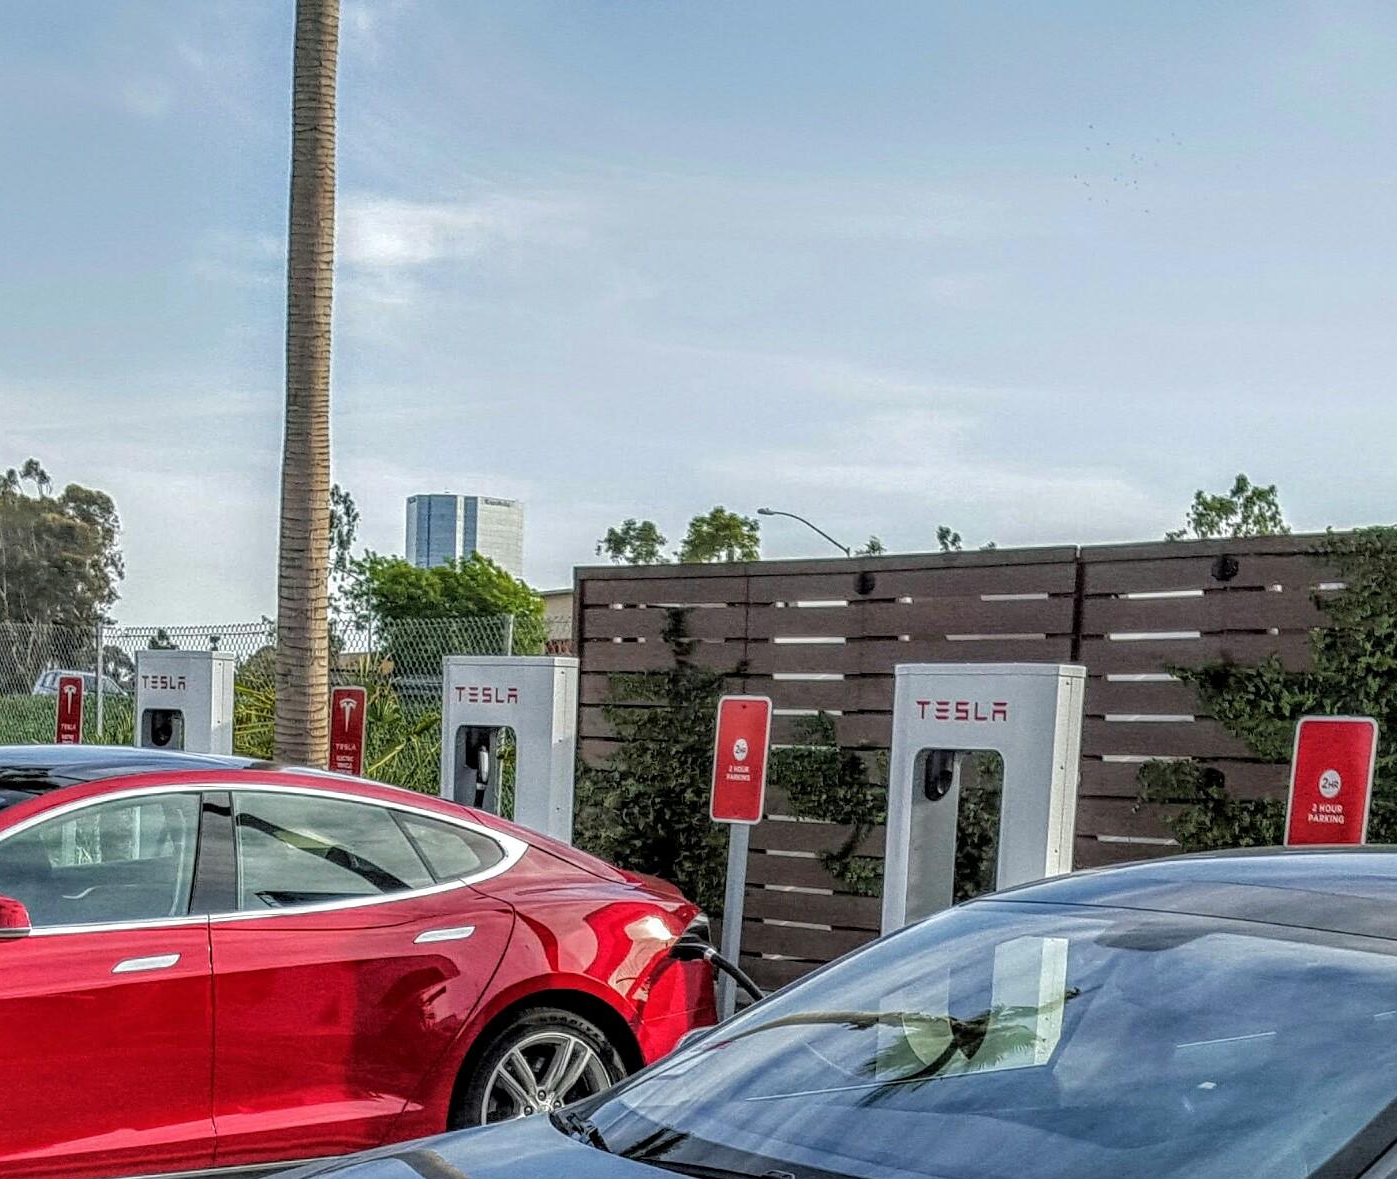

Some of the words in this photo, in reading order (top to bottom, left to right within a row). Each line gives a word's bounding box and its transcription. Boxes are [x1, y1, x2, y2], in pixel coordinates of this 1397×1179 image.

[141, 676, 186, 690] TESLA
[455, 686, 518, 704] TESLA
[915, 700, 1008, 721] TESLA
[1322, 777, 1339, 789] 2HR
[1311, 803, 1317, 812] 2
[1319, 804, 1343, 813] HOUR
[1307, 813, 1345, 824] PARKING
